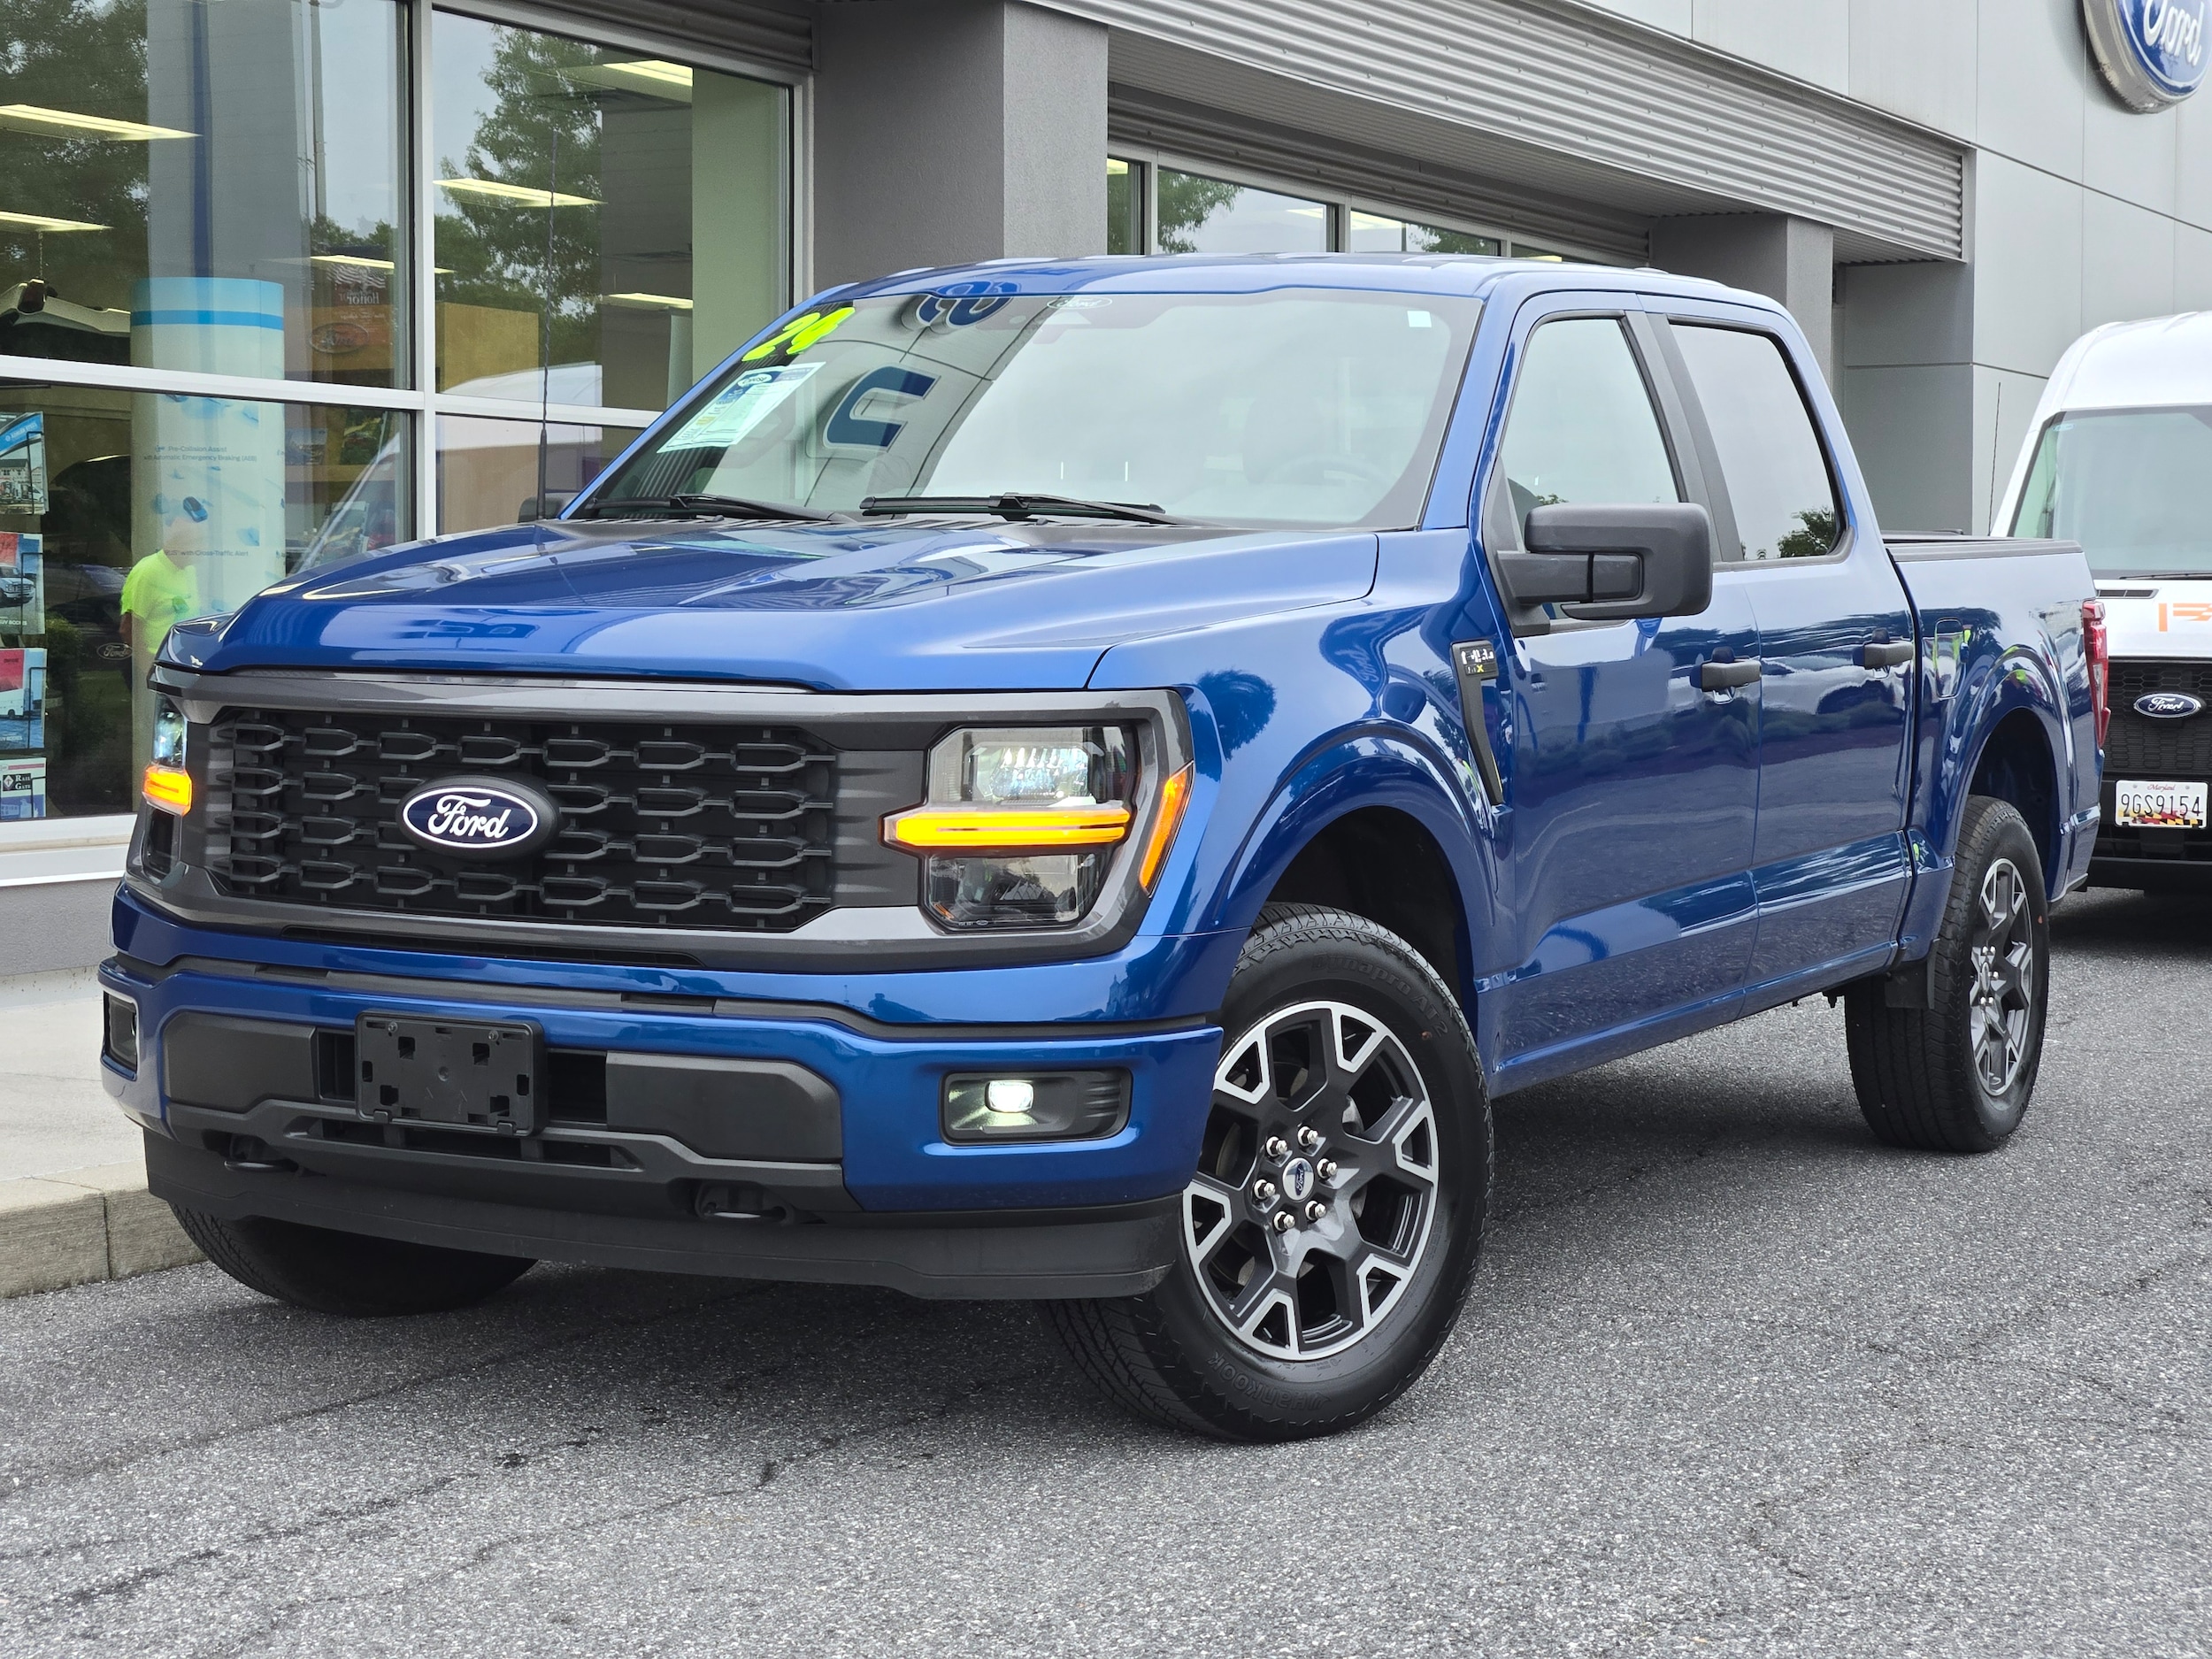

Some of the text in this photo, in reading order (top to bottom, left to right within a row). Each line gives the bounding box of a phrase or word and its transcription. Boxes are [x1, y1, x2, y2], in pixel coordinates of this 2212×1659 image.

[2147, 696, 2185, 712] Ford
[2147, 784, 2176, 793] Maryland
[2121, 794, 2203, 817] 9GS9154
[427, 795, 512, 839] Ford
